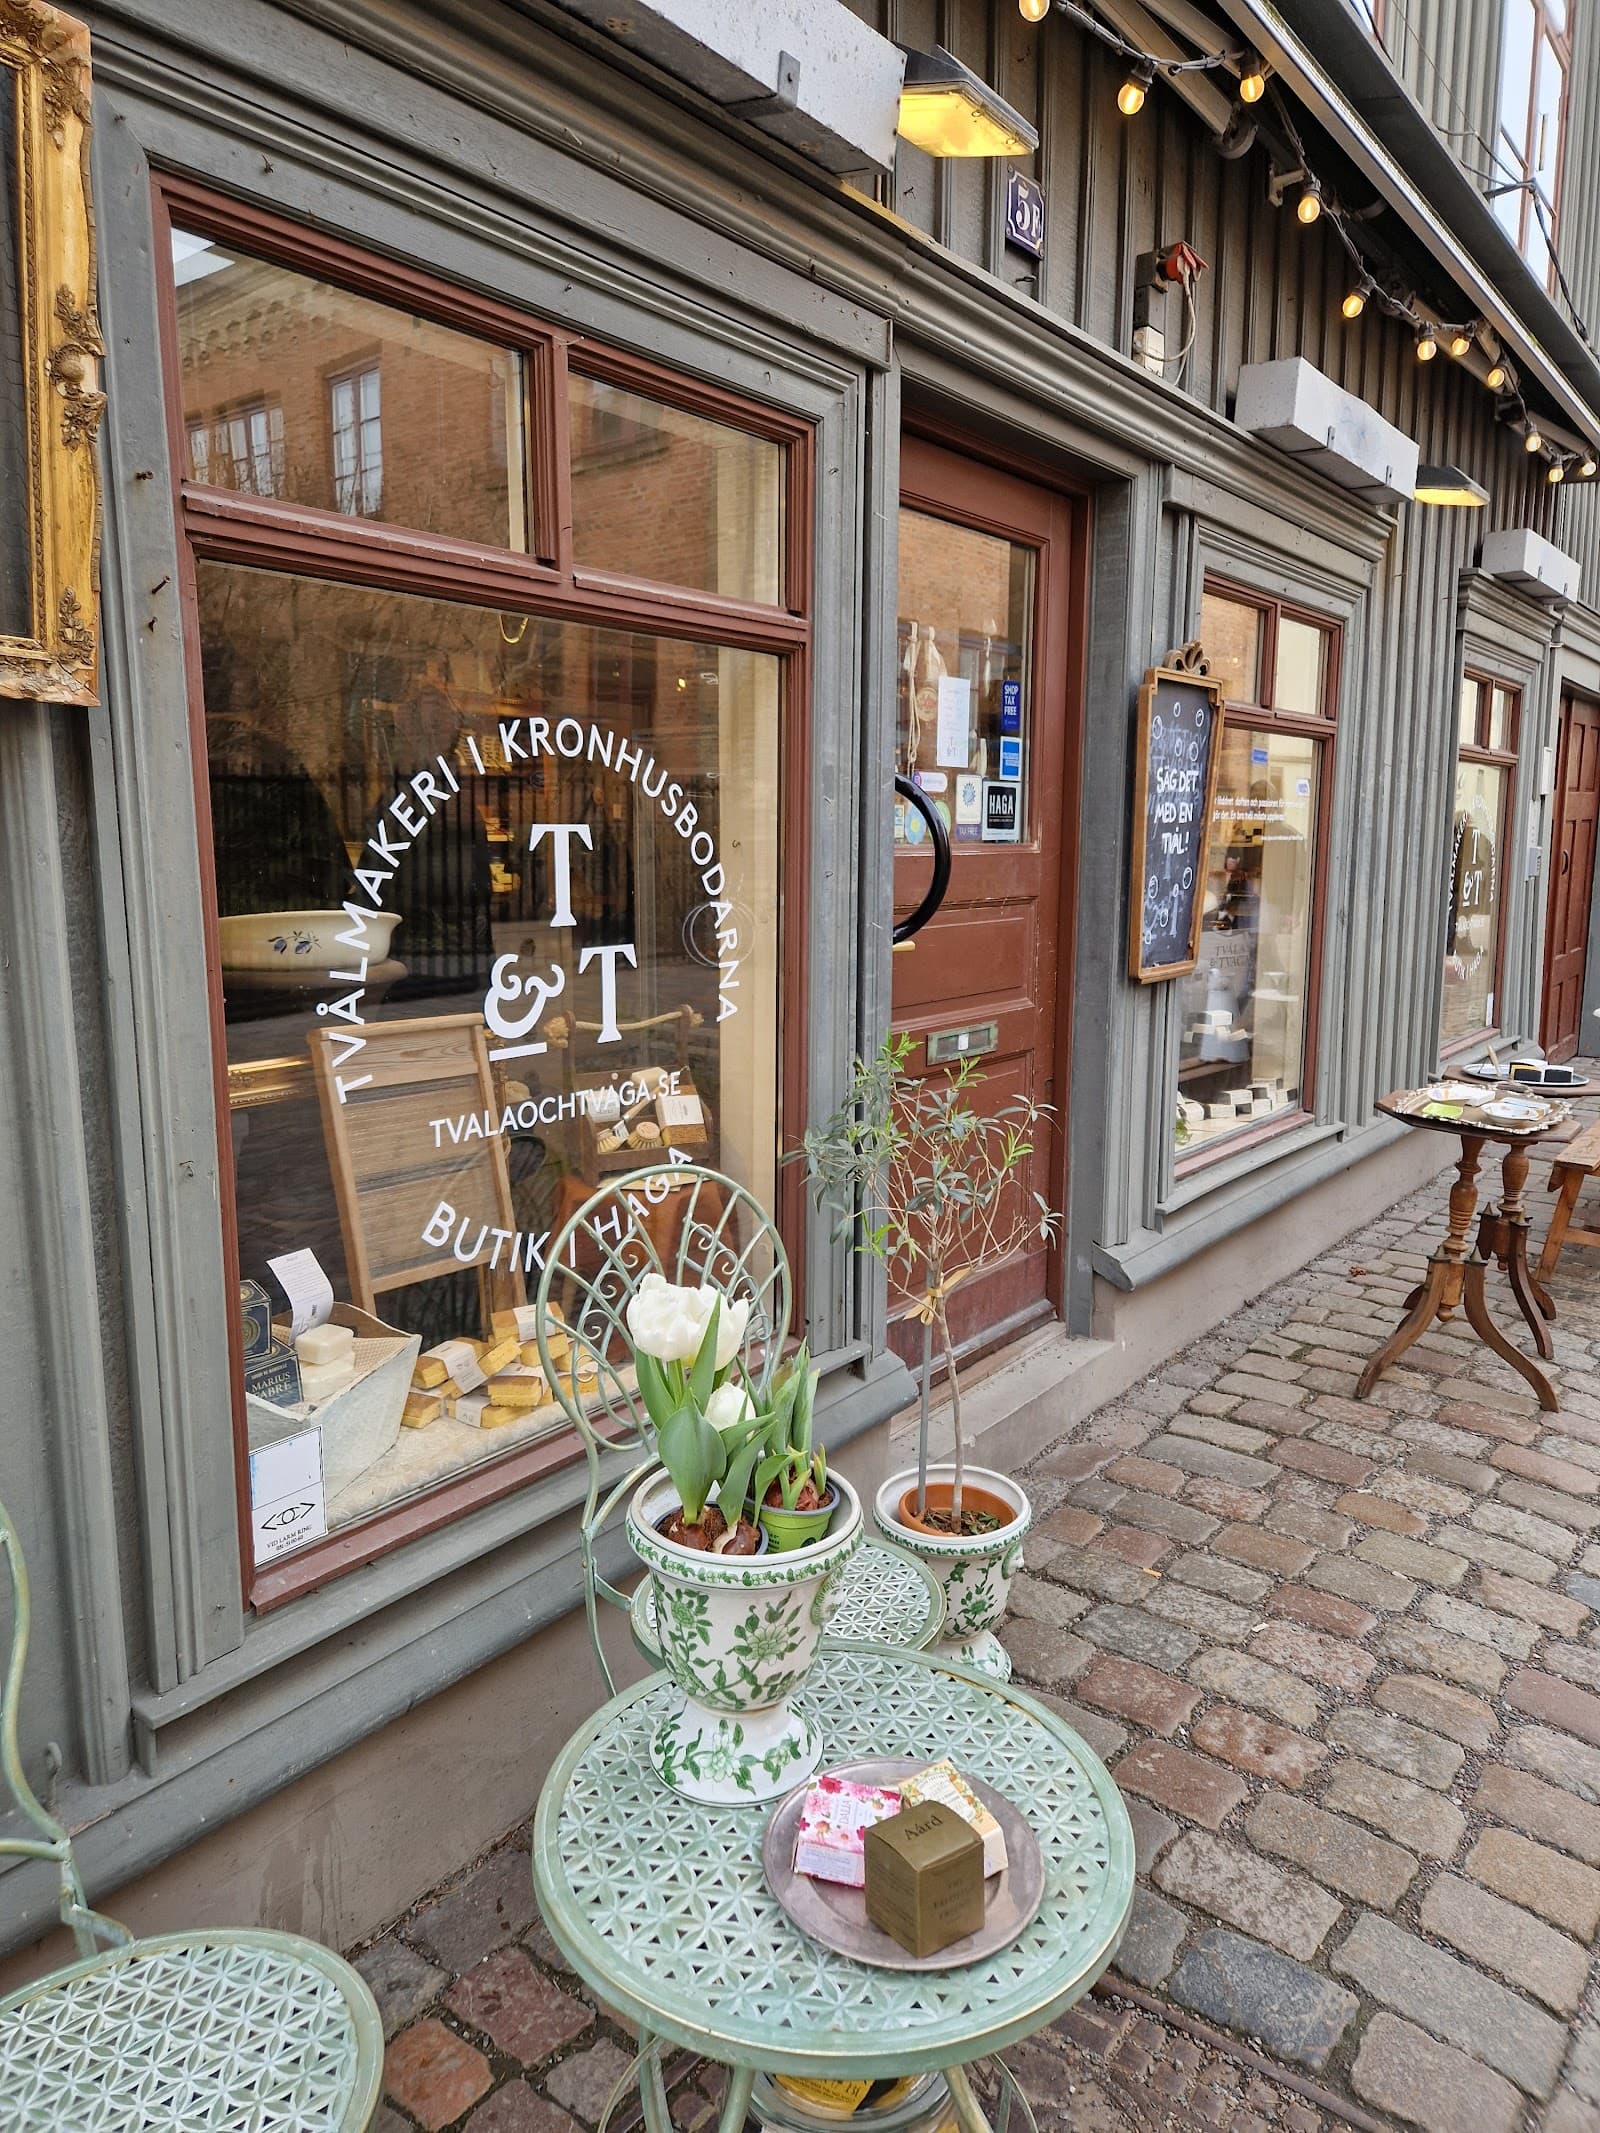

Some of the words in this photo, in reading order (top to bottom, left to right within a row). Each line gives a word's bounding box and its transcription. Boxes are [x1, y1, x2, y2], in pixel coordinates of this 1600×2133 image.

[1003, 684, 1019, 696] SHOP
[1004, 695, 1015, 706] TAX
[1004, 705, 1017, 716] FREE
[1179, 770, 1199, 793] DET
[988, 794, 1014, 815] HAGA
[1153, 802, 1177, 824] MED
[1178, 802, 1194, 824] EN
[528, 823, 594, 928] T
[317, 754, 461, 1104] TVÅLMAKERI
[466, 735, 487, 775] I
[498, 716, 739, 1023] KRONHUSBODARNA
[577, 943, 638, 1044] T
[428, 1070, 682, 1149] TVALAOCHTVAGA.SE
[421, 1200, 551, 1273] BUTIK
[593, 1146, 693, 1251] HAGA
[251, 1371, 291, 1393] MARIUS
[279, 1531, 296, 1543] LARM
